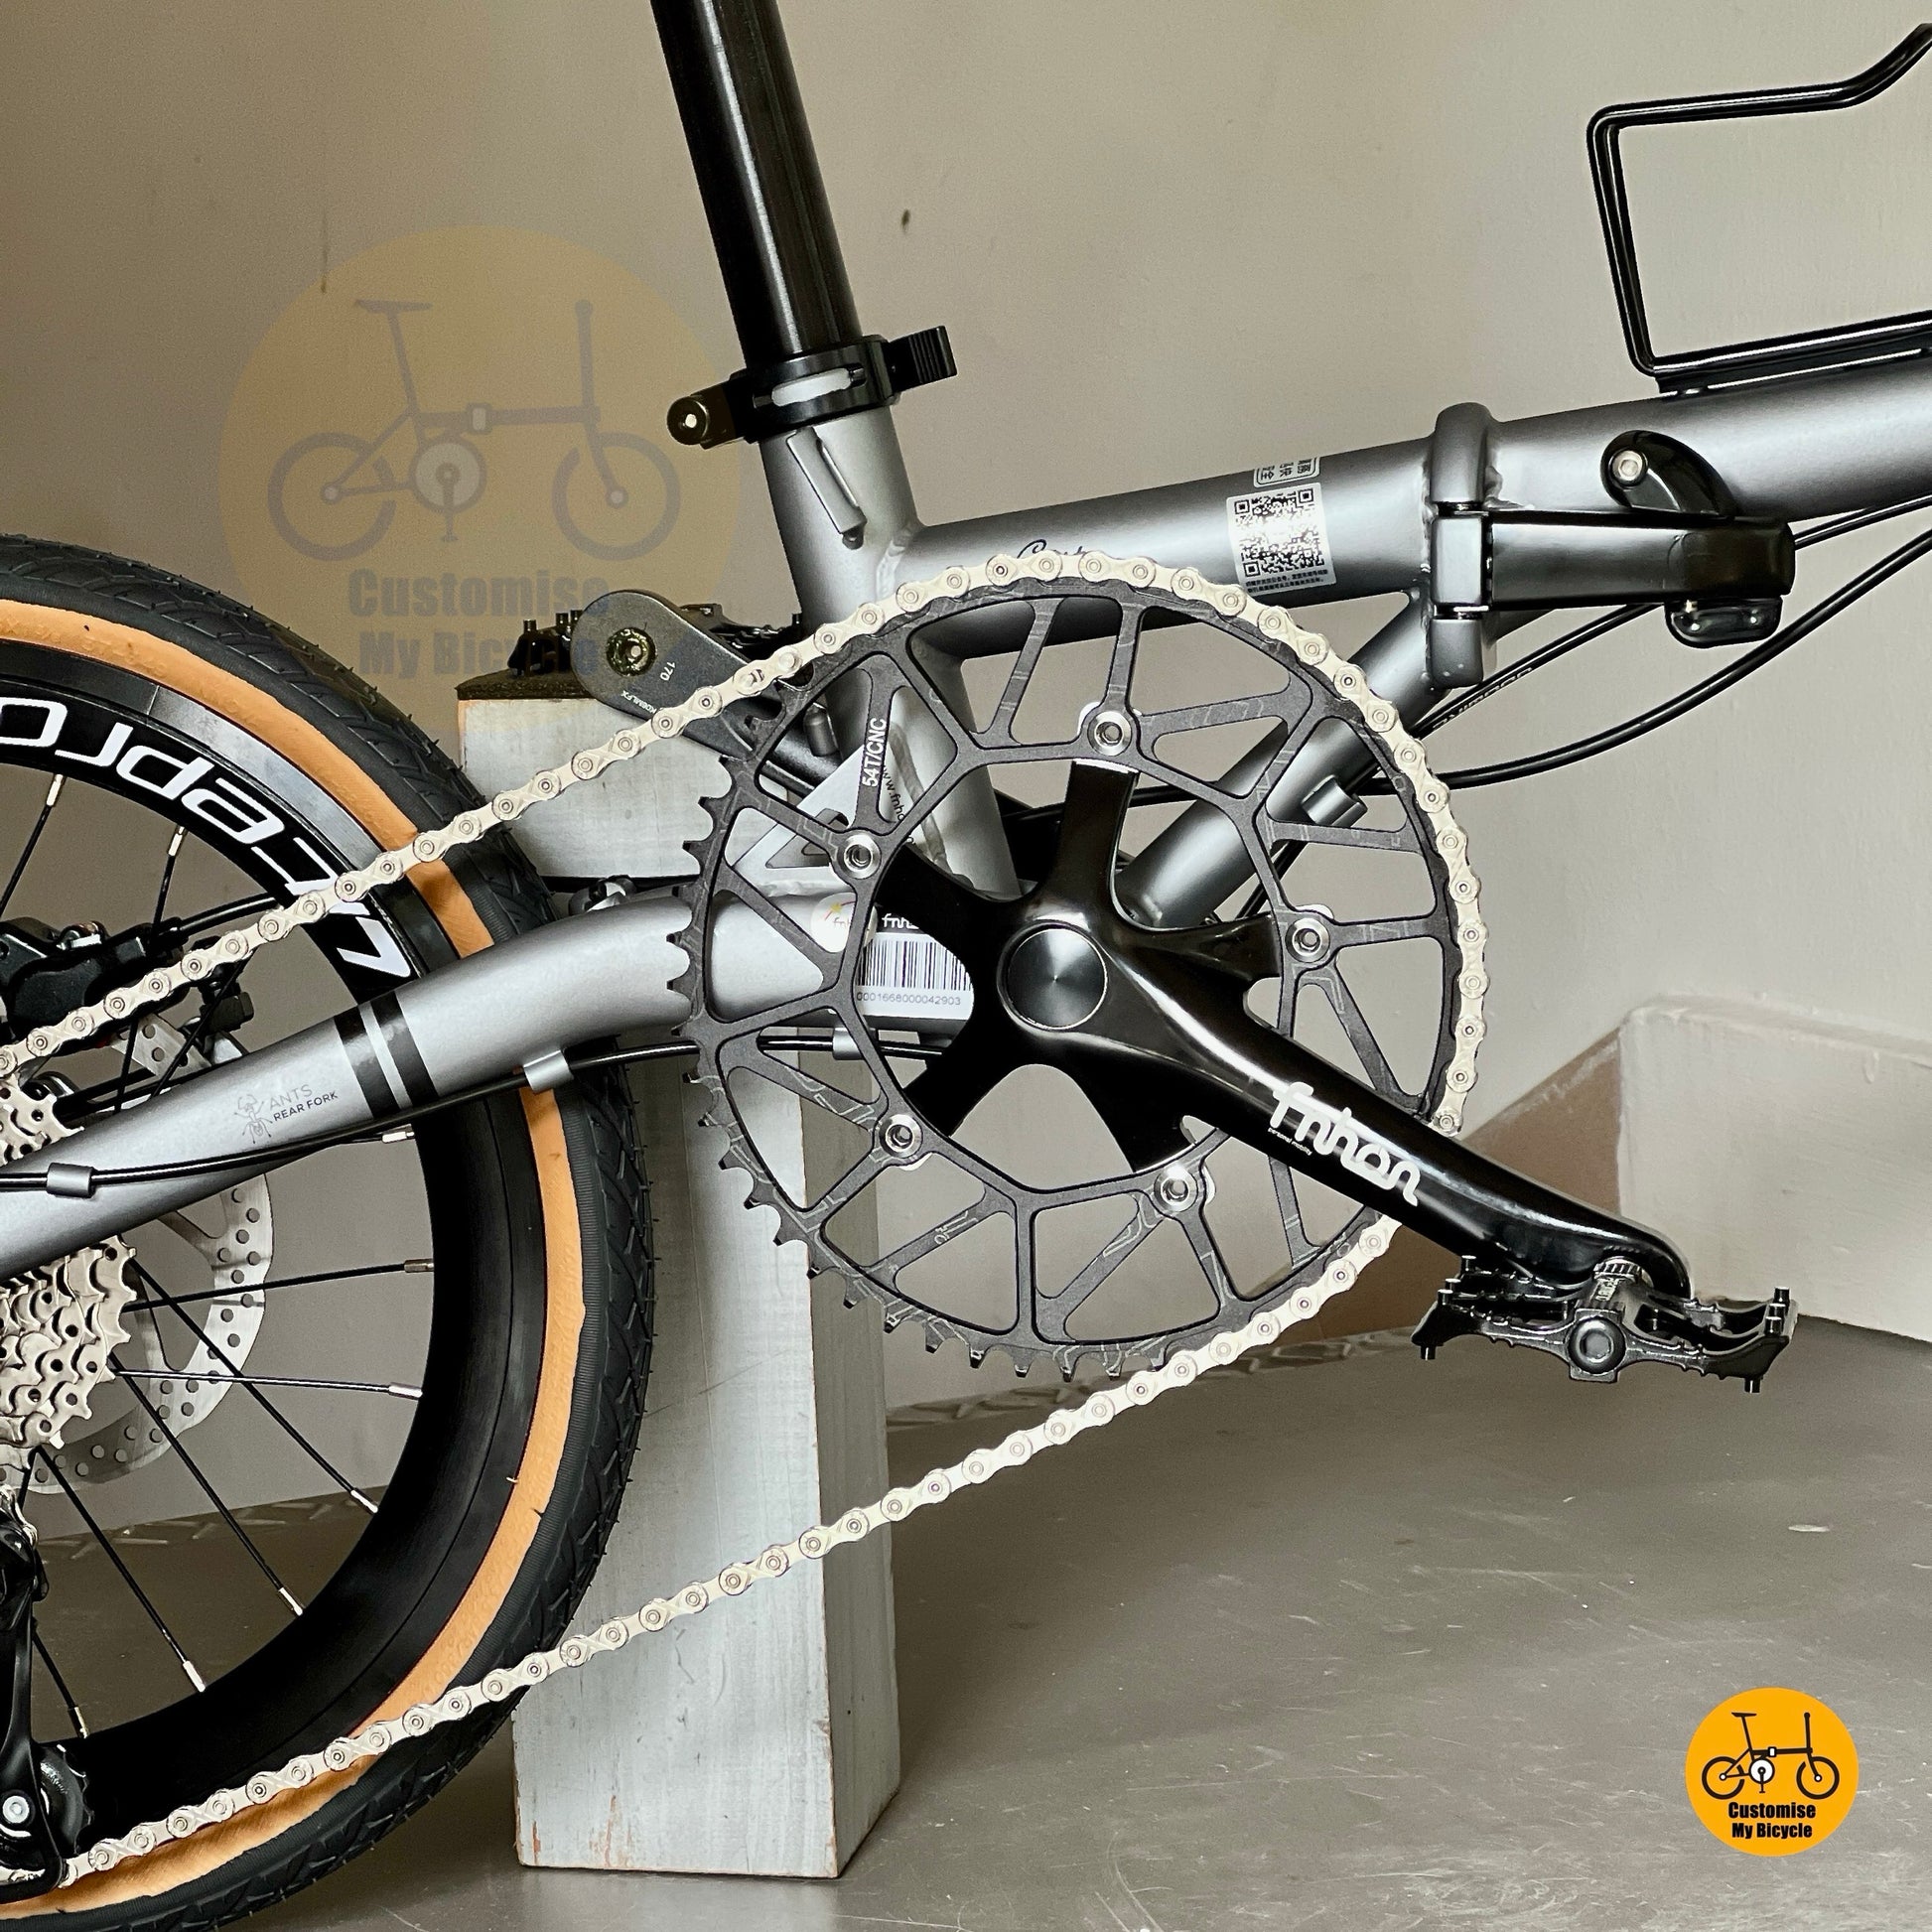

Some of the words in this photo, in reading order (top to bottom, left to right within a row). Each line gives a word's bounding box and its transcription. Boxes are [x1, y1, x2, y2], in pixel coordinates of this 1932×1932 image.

[659, 661, 676, 681] 170
[861, 717, 888, 787] 54T/CNC
[269, 1084, 313, 1110] ANTS
[273, 1103, 305, 1122] REAR
[306, 1091, 339, 1110] FORK
[1269, 1081, 1421, 1207] fnhon
